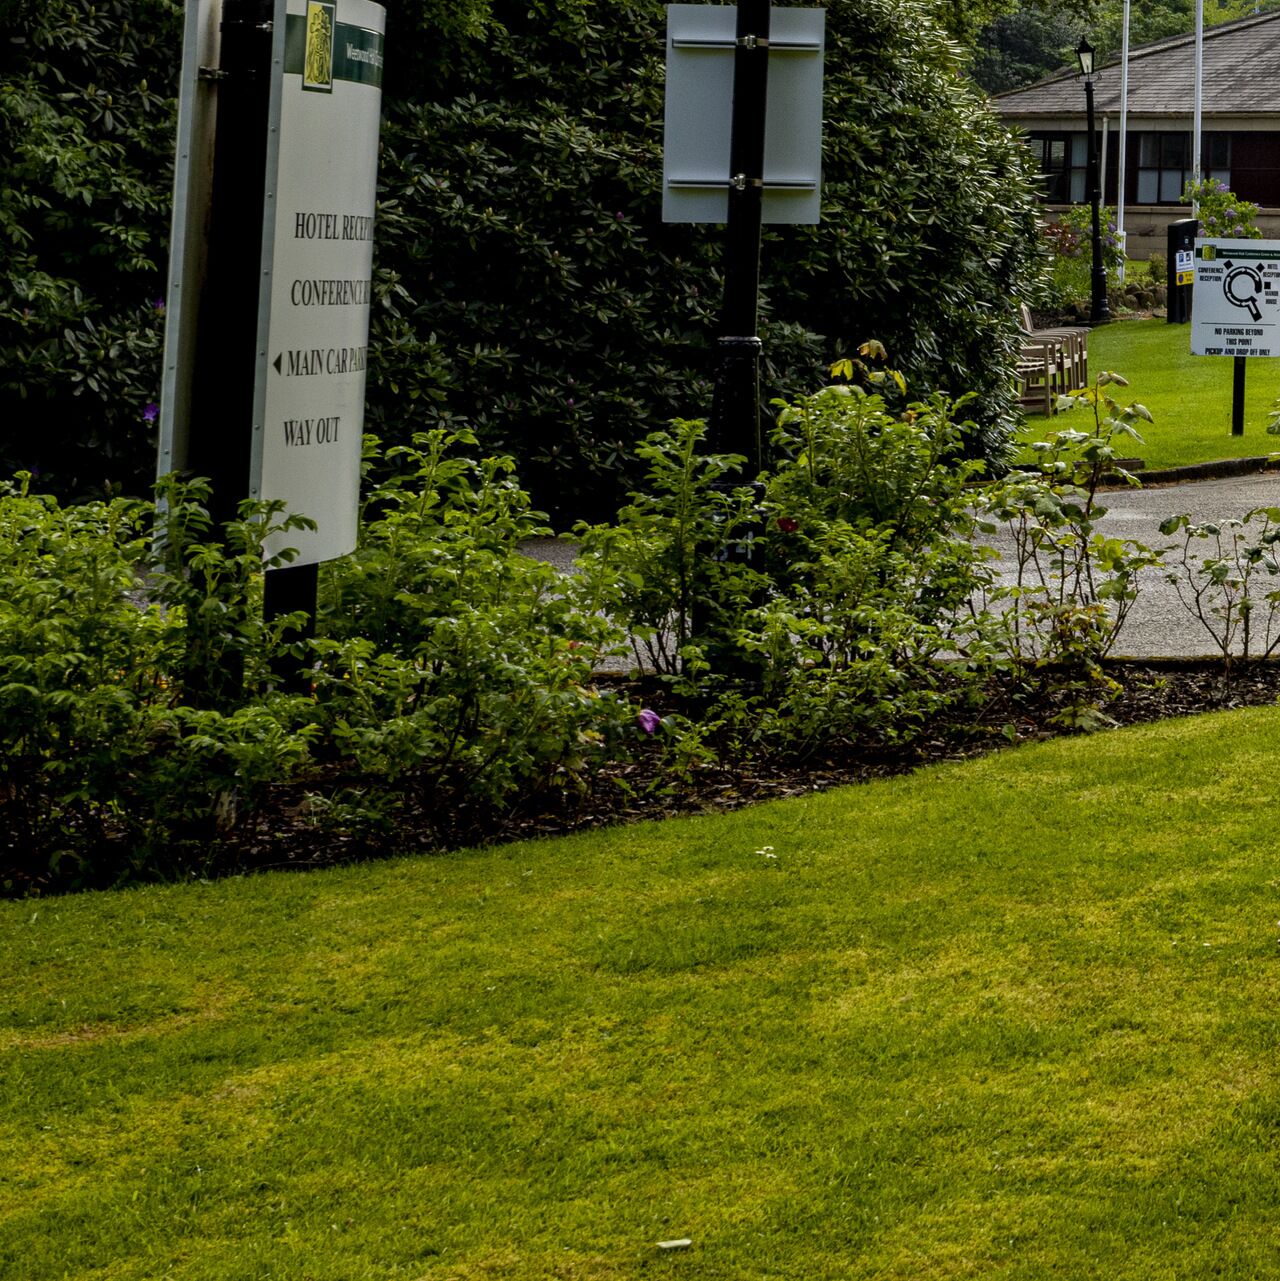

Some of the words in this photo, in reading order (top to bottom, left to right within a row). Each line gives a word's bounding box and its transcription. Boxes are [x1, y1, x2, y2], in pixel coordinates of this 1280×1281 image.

[294, 212, 339, 239] HOTEL
[291, 279, 363, 306] CONFERENCE
[287, 349, 324, 376] MAIN
[326, 348, 347, 374] CAR
[283, 418, 314, 447] WAY
[316, 416, 340, 444] OUT
